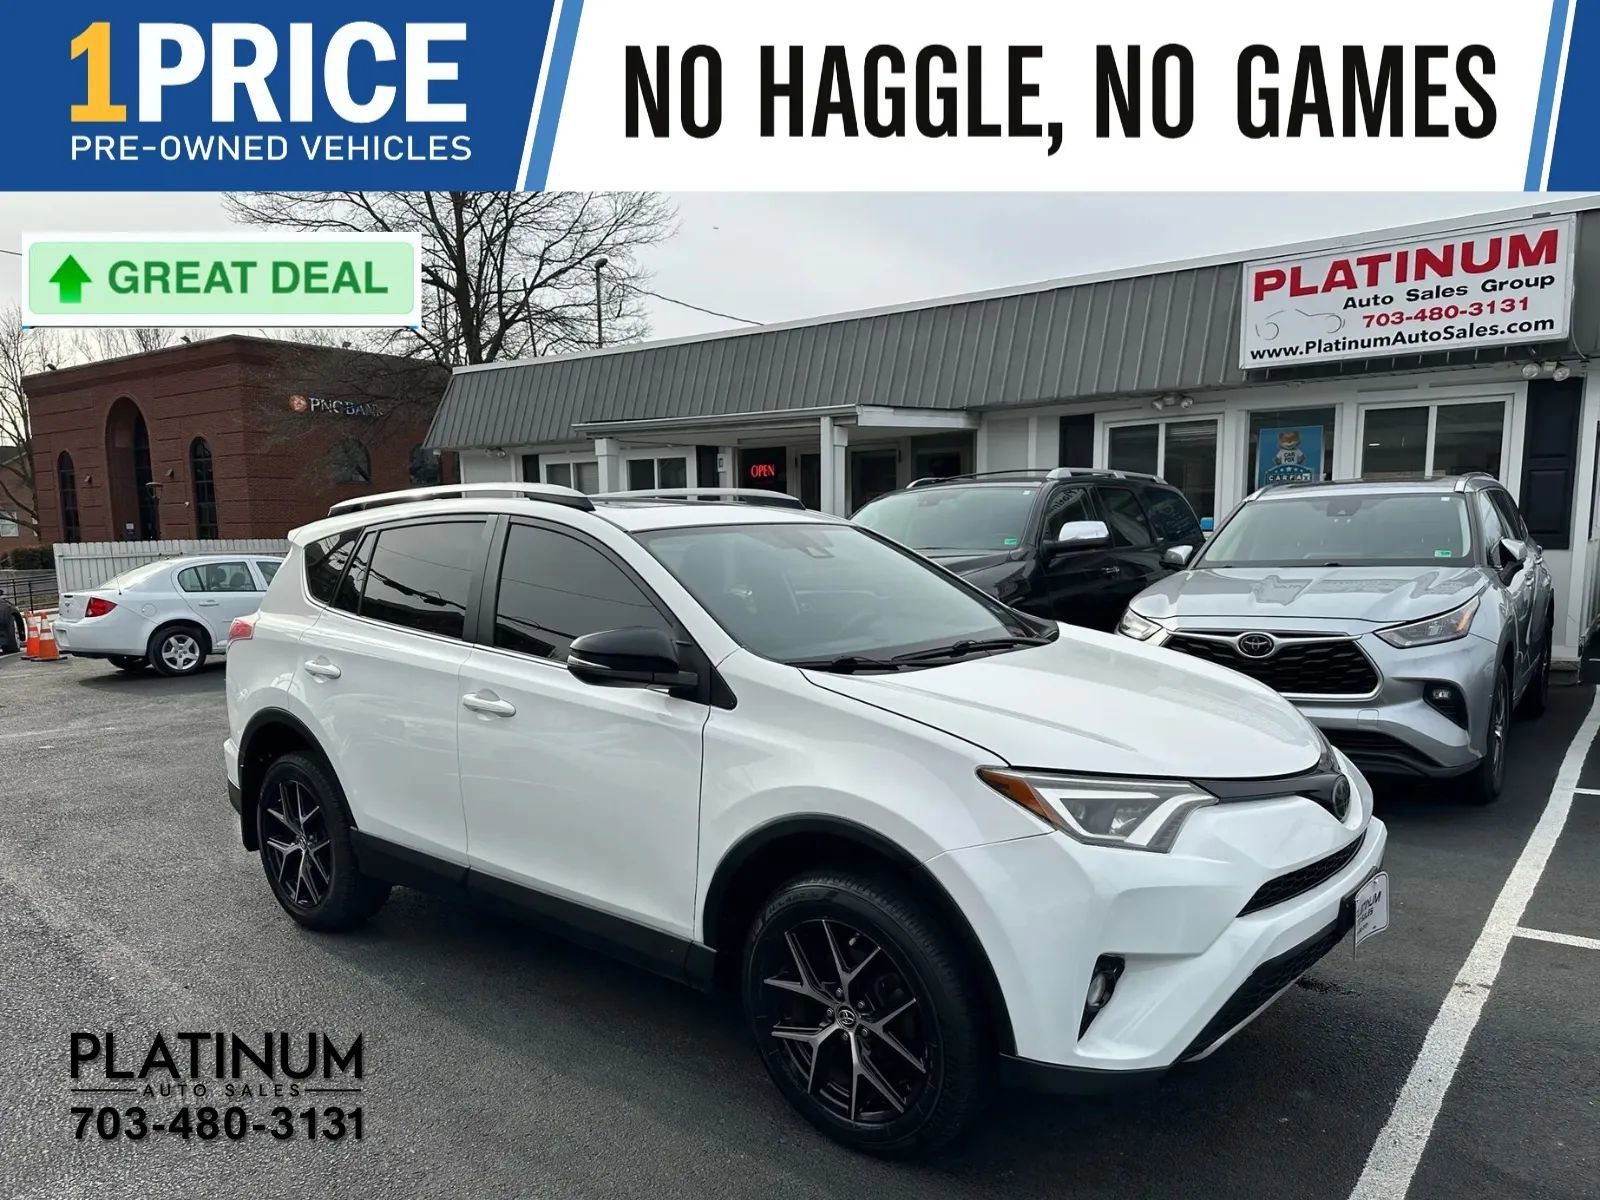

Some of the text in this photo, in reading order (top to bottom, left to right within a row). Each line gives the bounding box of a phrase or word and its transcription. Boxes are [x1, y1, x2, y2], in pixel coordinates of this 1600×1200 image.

[1253, 229, 1559, 302] PLATINUM
[1343, 274, 1555, 310] Auto Sales Group
[1362, 296, 1529, 328] 703-480-3131
[1250, 318, 1555, 360] www.PlatinumAutoSales.com
[308, 397, 343, 414] PNC
[750, 463, 776, 478] OPEN
[1268, 473, 1312, 481] CARFAX
